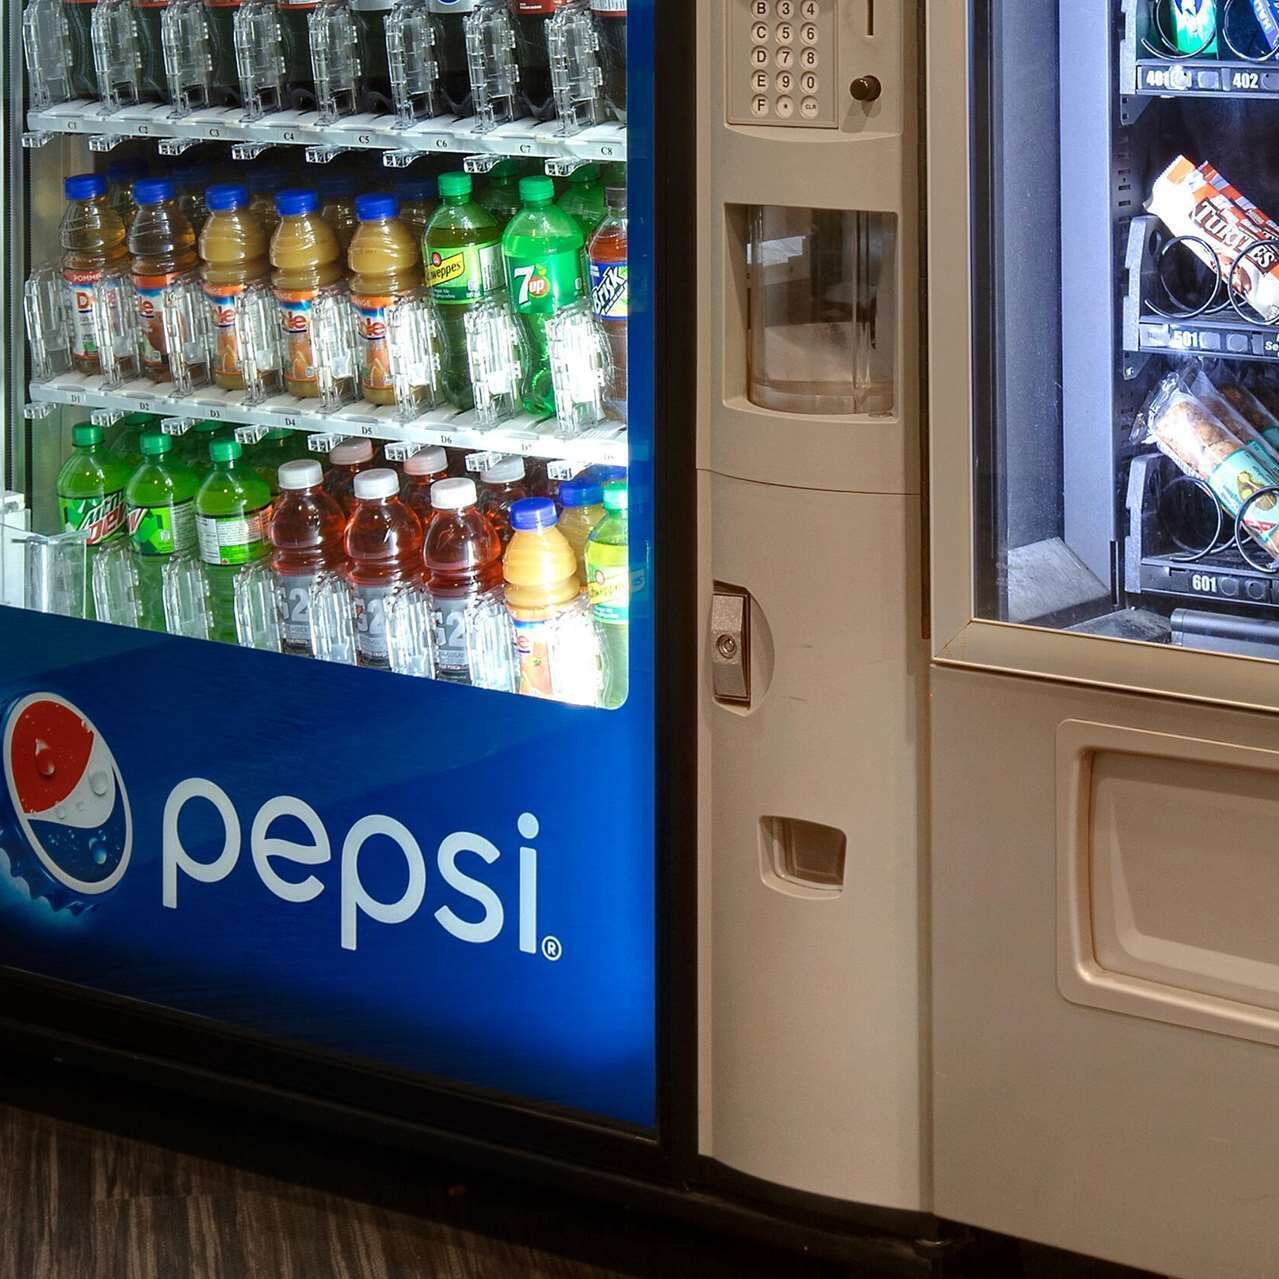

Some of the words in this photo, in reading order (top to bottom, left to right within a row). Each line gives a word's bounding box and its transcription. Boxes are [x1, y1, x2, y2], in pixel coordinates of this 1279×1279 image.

[757, 2, 766, 14] B
[782, 2, 790, 15] 3
[807, 3, 815, 15] 4
[757, 26, 766, 38] C
[782, 27, 790, 39] 5
[807, 27, 814, 40] 6
[757, 51, 766, 63] D
[783, 51, 790, 63] 7
[807, 52, 814, 64] 8
[758, 75, 766, 87] E
[782, 76, 790, 88] 9
[807, 77, 814, 88] 0
[1233, 72, 1259, 89] 402
[758, 99, 766, 111] F
[284, 132, 294, 140] C4
[436, 139, 447, 148] C6
[601, 146, 612, 155] C8
[514, 265, 534, 304] 7
[528, 279, 545, 293] up
[1192, 575, 1217, 592] 601
[162, 778, 540, 954] pepsi
